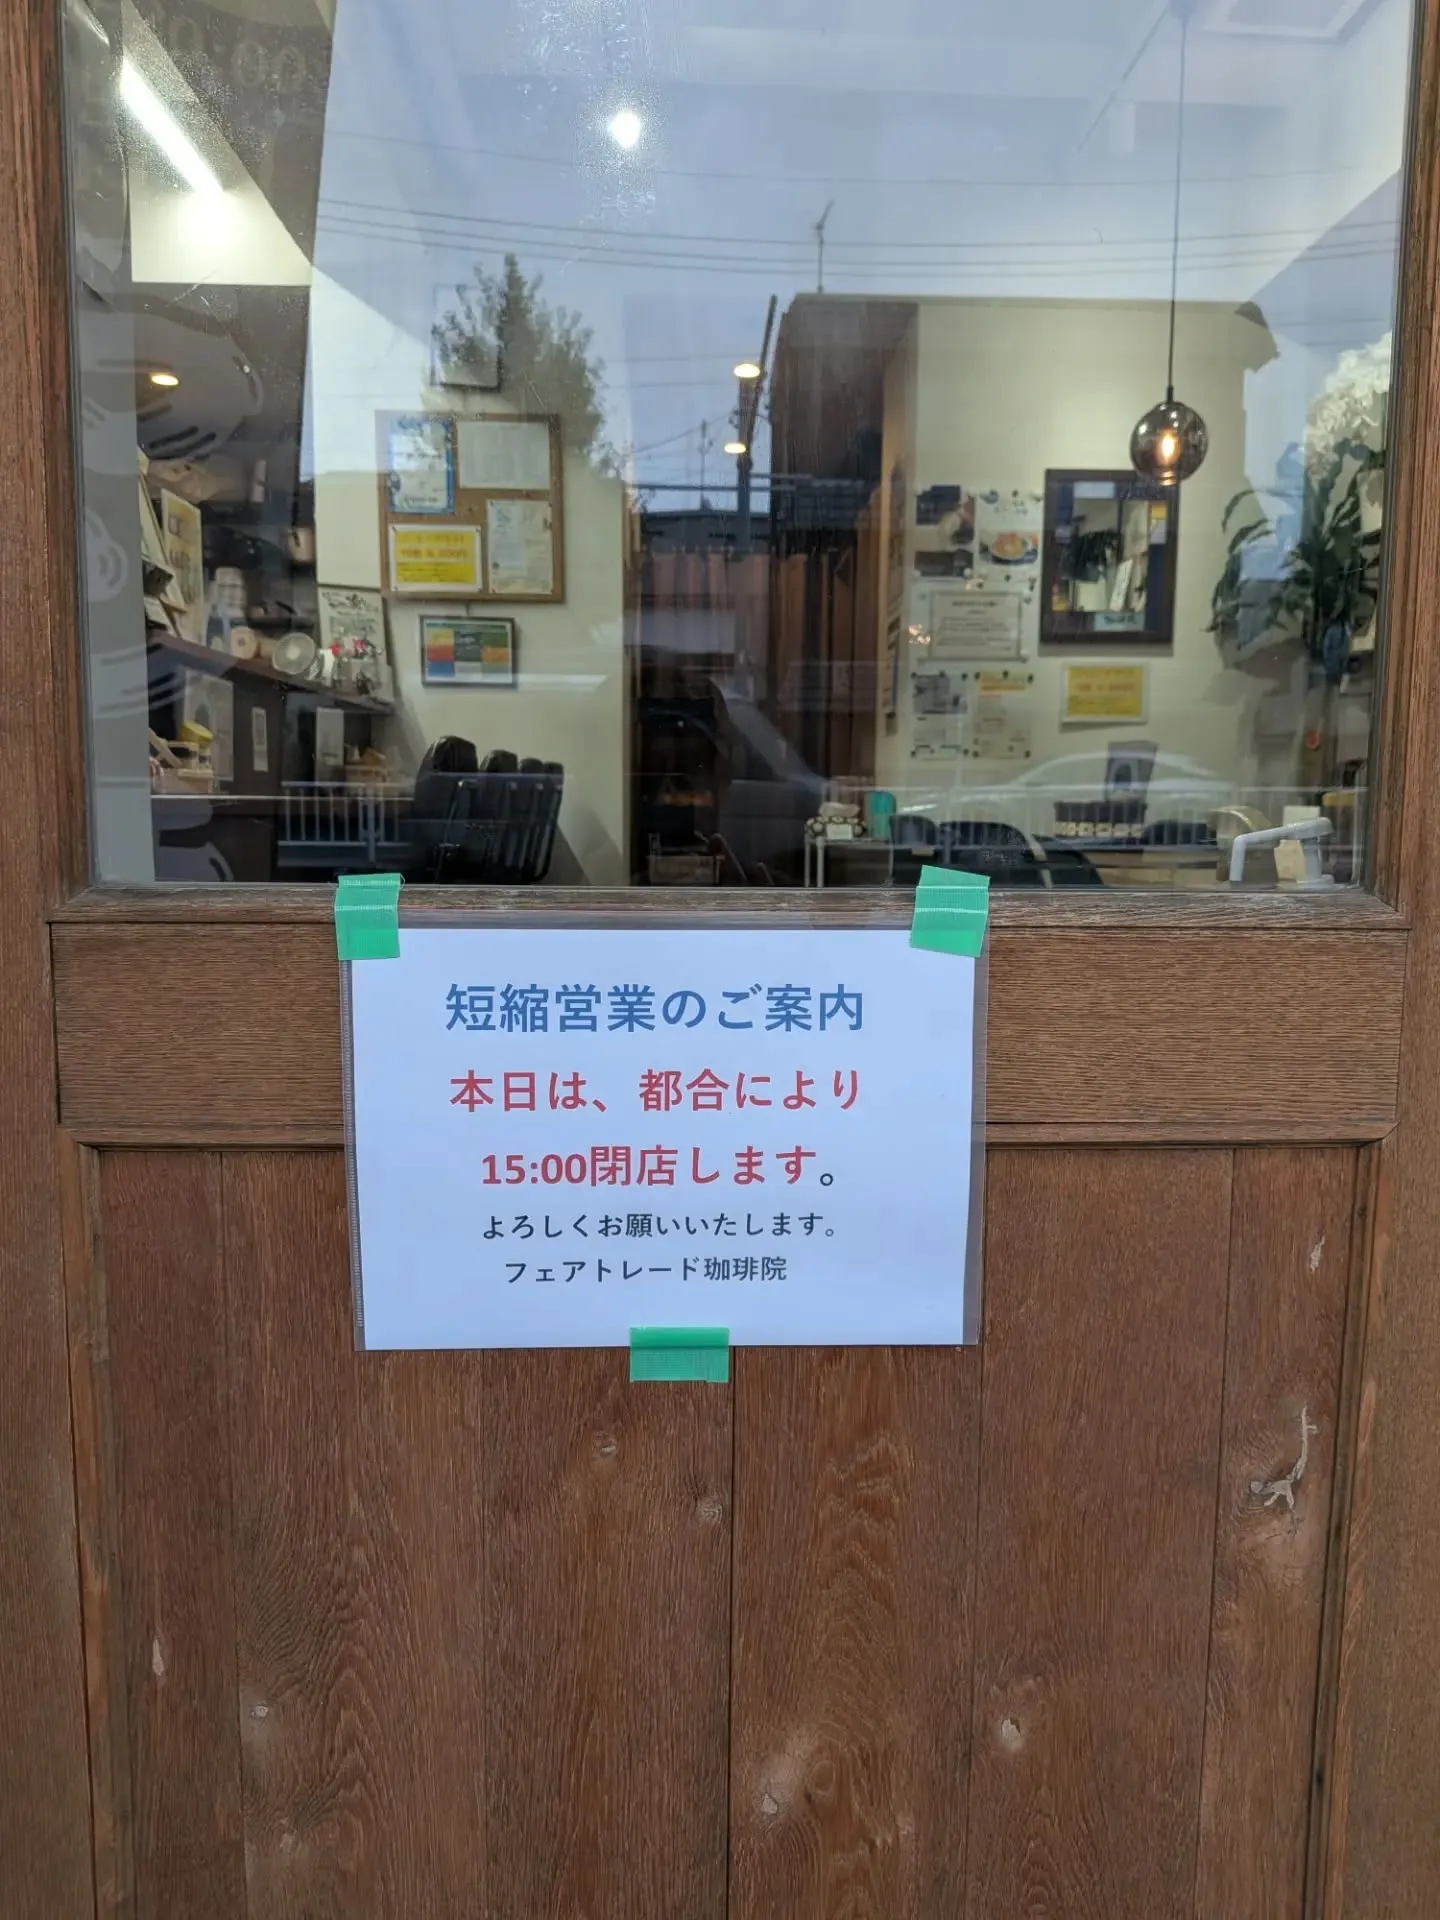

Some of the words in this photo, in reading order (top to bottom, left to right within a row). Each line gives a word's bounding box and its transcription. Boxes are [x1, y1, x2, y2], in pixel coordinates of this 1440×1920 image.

[446, 983, 862, 1032] 短縮営業のご案内
[450, 1069, 858, 1112] 本日は、都合により
[481, 1145, 834, 1186] 15:00閉店します。
[483, 1212, 836, 1239] よろしくお願いいたします。
[505, 1256, 787, 1283] フェアトレード珈琲院
